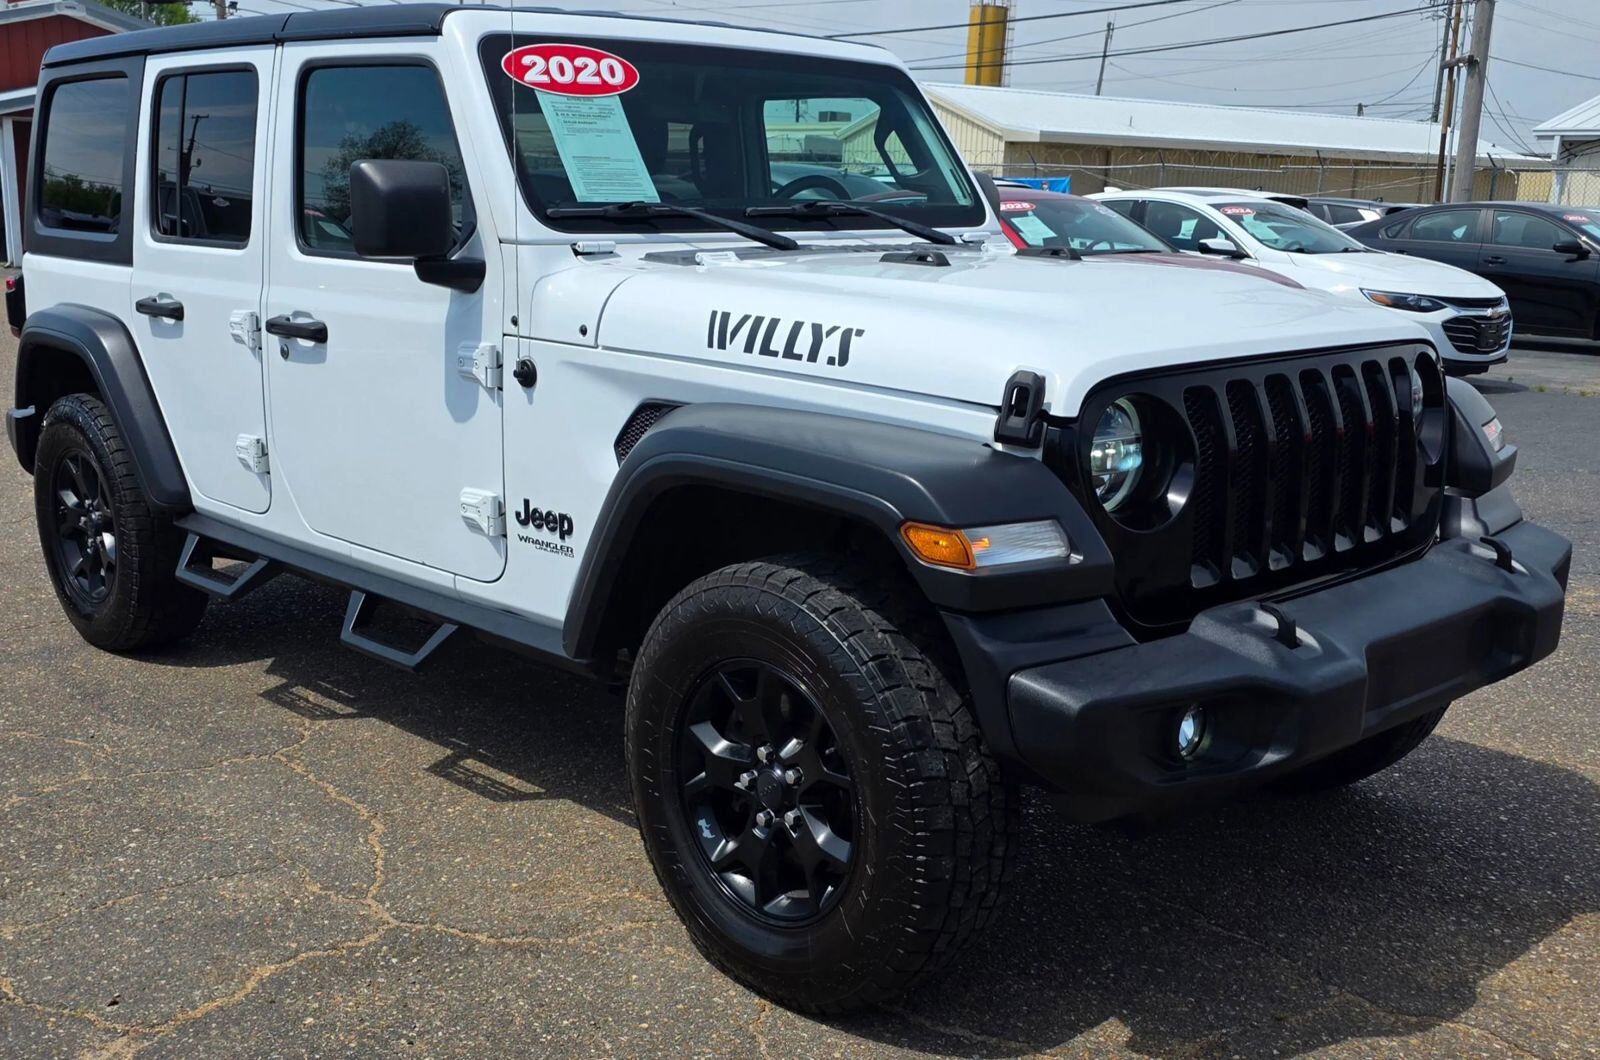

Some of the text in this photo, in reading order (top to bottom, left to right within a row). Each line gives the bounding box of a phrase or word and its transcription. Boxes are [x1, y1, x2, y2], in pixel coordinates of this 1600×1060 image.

[521, 55, 625, 86] 2020
[707, 309, 865, 367] WILLYS
[515, 497, 574, 541] Jeep
[517, 533, 574, 554] WRANGLER
[535, 545, 575, 558] UNLIMITED
